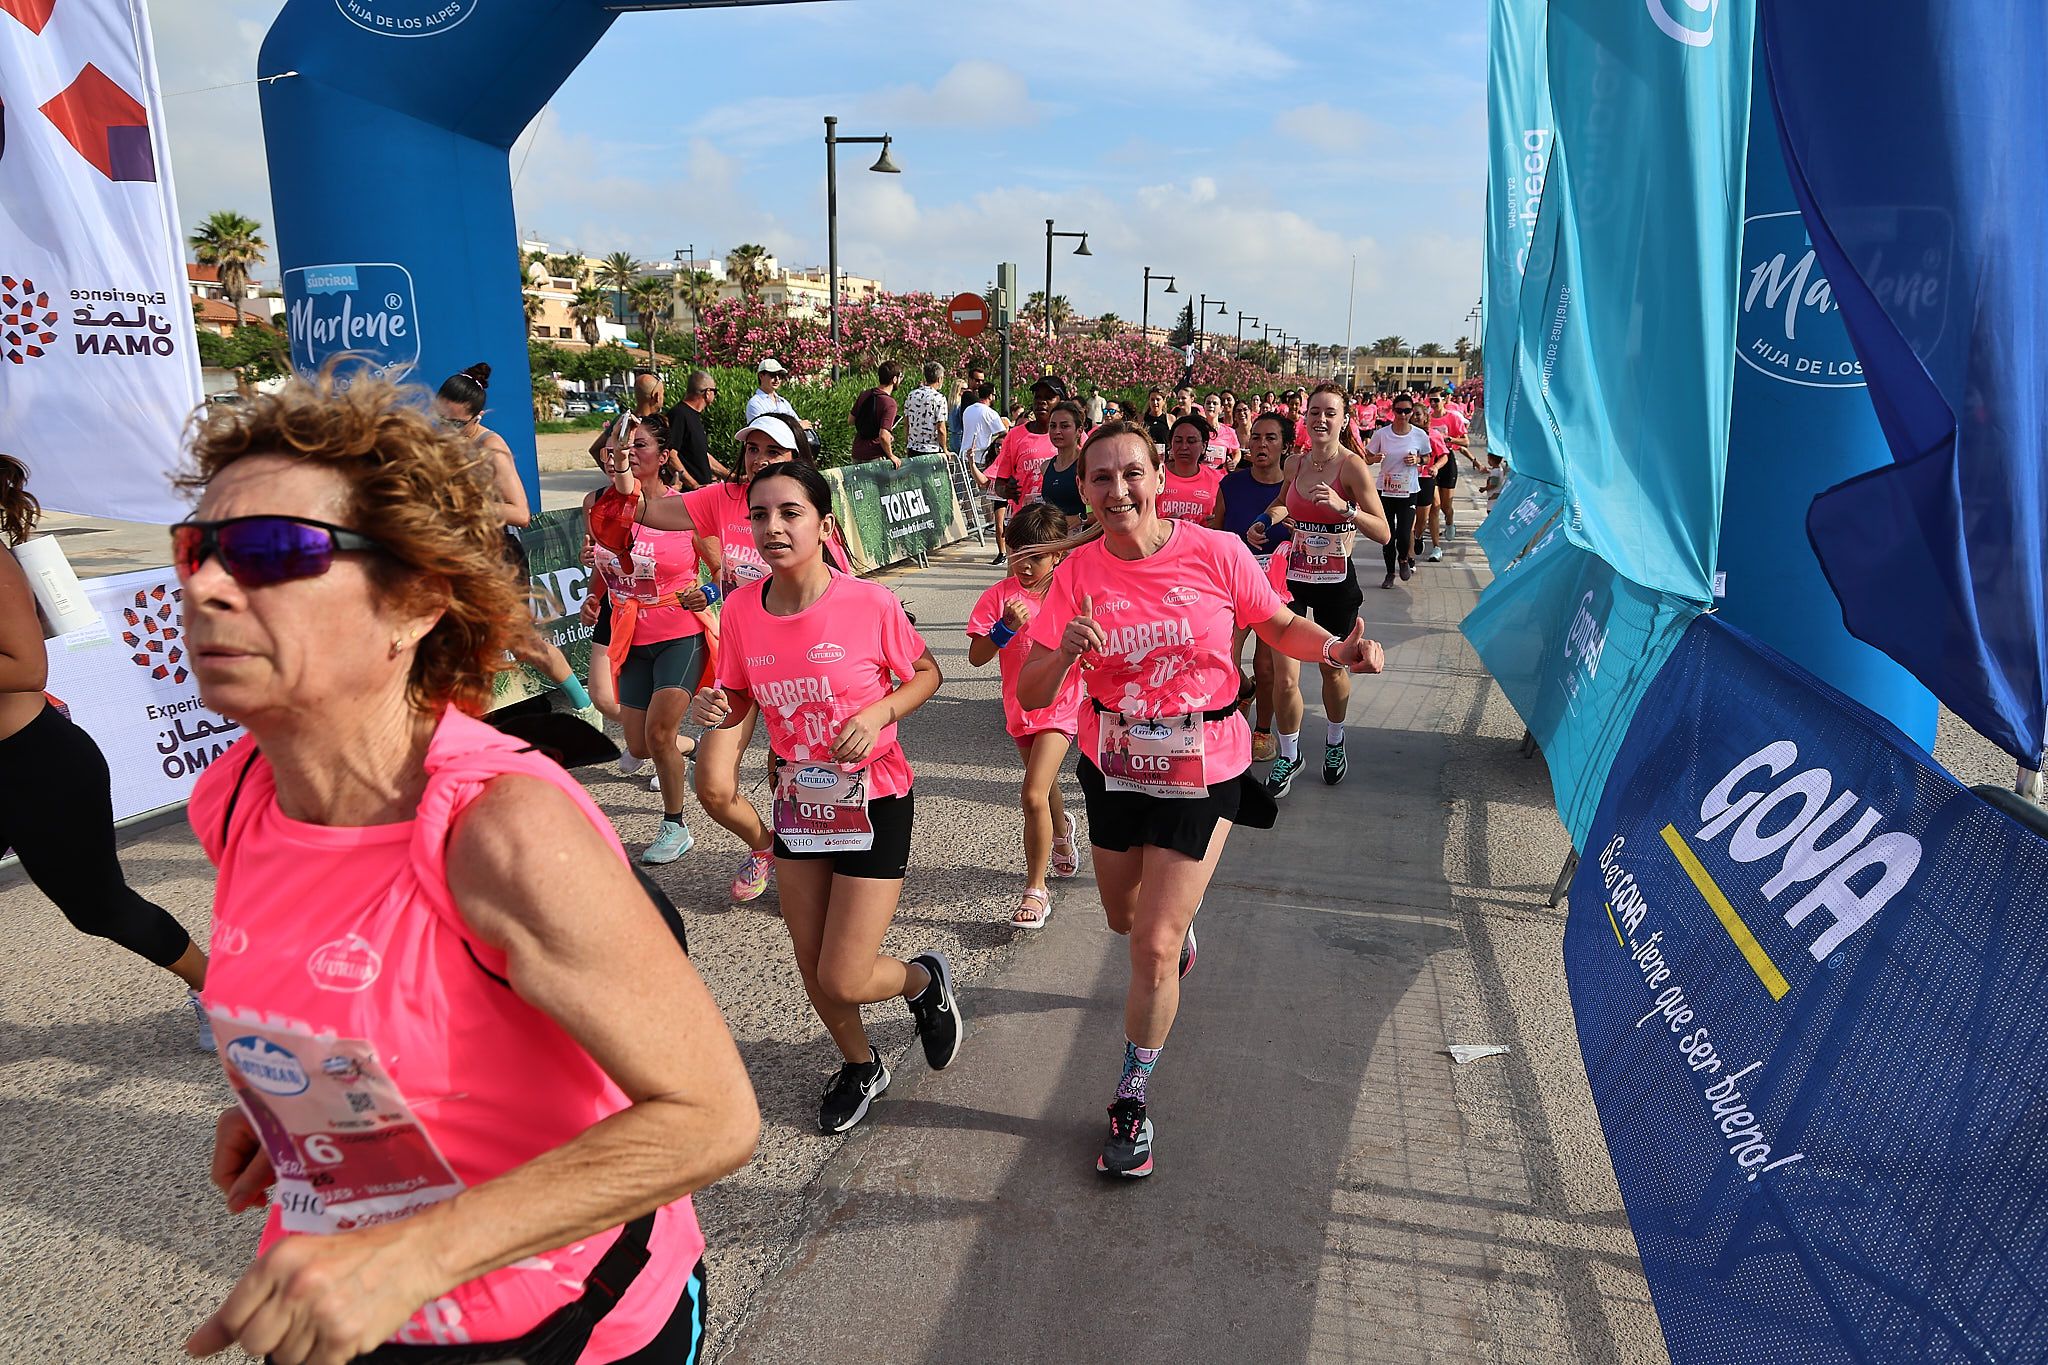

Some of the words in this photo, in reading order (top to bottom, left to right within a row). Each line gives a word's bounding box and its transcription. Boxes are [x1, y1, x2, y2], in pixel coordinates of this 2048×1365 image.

[347, 1, 372, 22] HIJA
[376, 15, 393, 28] DE
[397, 18, 422, 29] LOS
[426, 1, 461, 27] ALPES
[291, 293, 406, 363] Marlene
[1752, 338, 1790, 368] HIJA
[1795, 357, 1822, 375] DE
[1828, 360, 1863, 376] LOS
[1162, 500, 1203, 515] CARRERA
[1300, 522, 1328, 532] PUMA
[1334, 523, 1355, 533] PUM
[1306, 555, 1328, 564] 016
[1095, 600, 1131, 616] OYSHO
[1167, 594, 1197, 603] ASTURIANA
[553, 629, 566, 647] de
[567, 625, 577, 643] ti
[578, 623, 596, 640] des
[1100, 617, 1195, 657] CARRERA
[809, 650, 843, 660] ASTURIANA
[752, 675, 833, 708] CARRERA
[146, 695, 206, 721] Experie
[1131, 727, 1169, 737] ASTURIANA
[163, 737, 242, 779] OMA
[1131, 755, 1171, 771] 016
[799, 773, 835, 784] ASTURIANA
[800, 803, 836, 820] 016
[1694, 740, 1922, 962] GOYA
[1605, 865, 1624, 889] es
[1611, 873, 1648, 937] GOYA
[1637, 986, 1693, 1032] que
[1680, 1028, 1722, 1075] ser
[1705, 1061, 1804, 1182] bueno!
